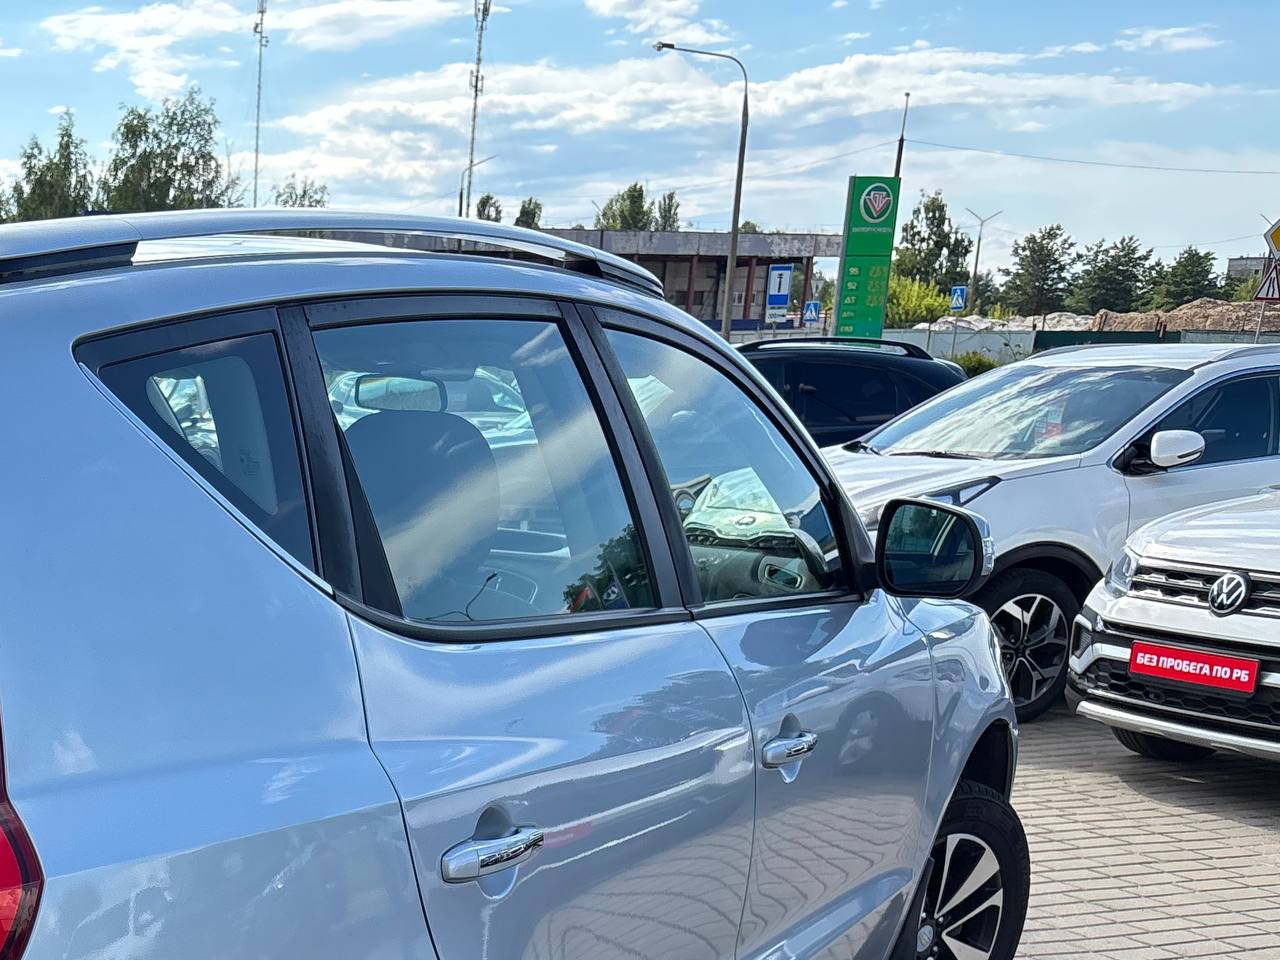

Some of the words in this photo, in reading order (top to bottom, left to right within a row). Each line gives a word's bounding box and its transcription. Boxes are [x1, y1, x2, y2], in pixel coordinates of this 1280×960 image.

[1136, 652, 1158, 667] БЕЗ
[1158, 656, 1211, 676] ПРОБЕГА
[1212, 665, 1231, 679] ПО
[1232, 668, 1250, 682] РБ
